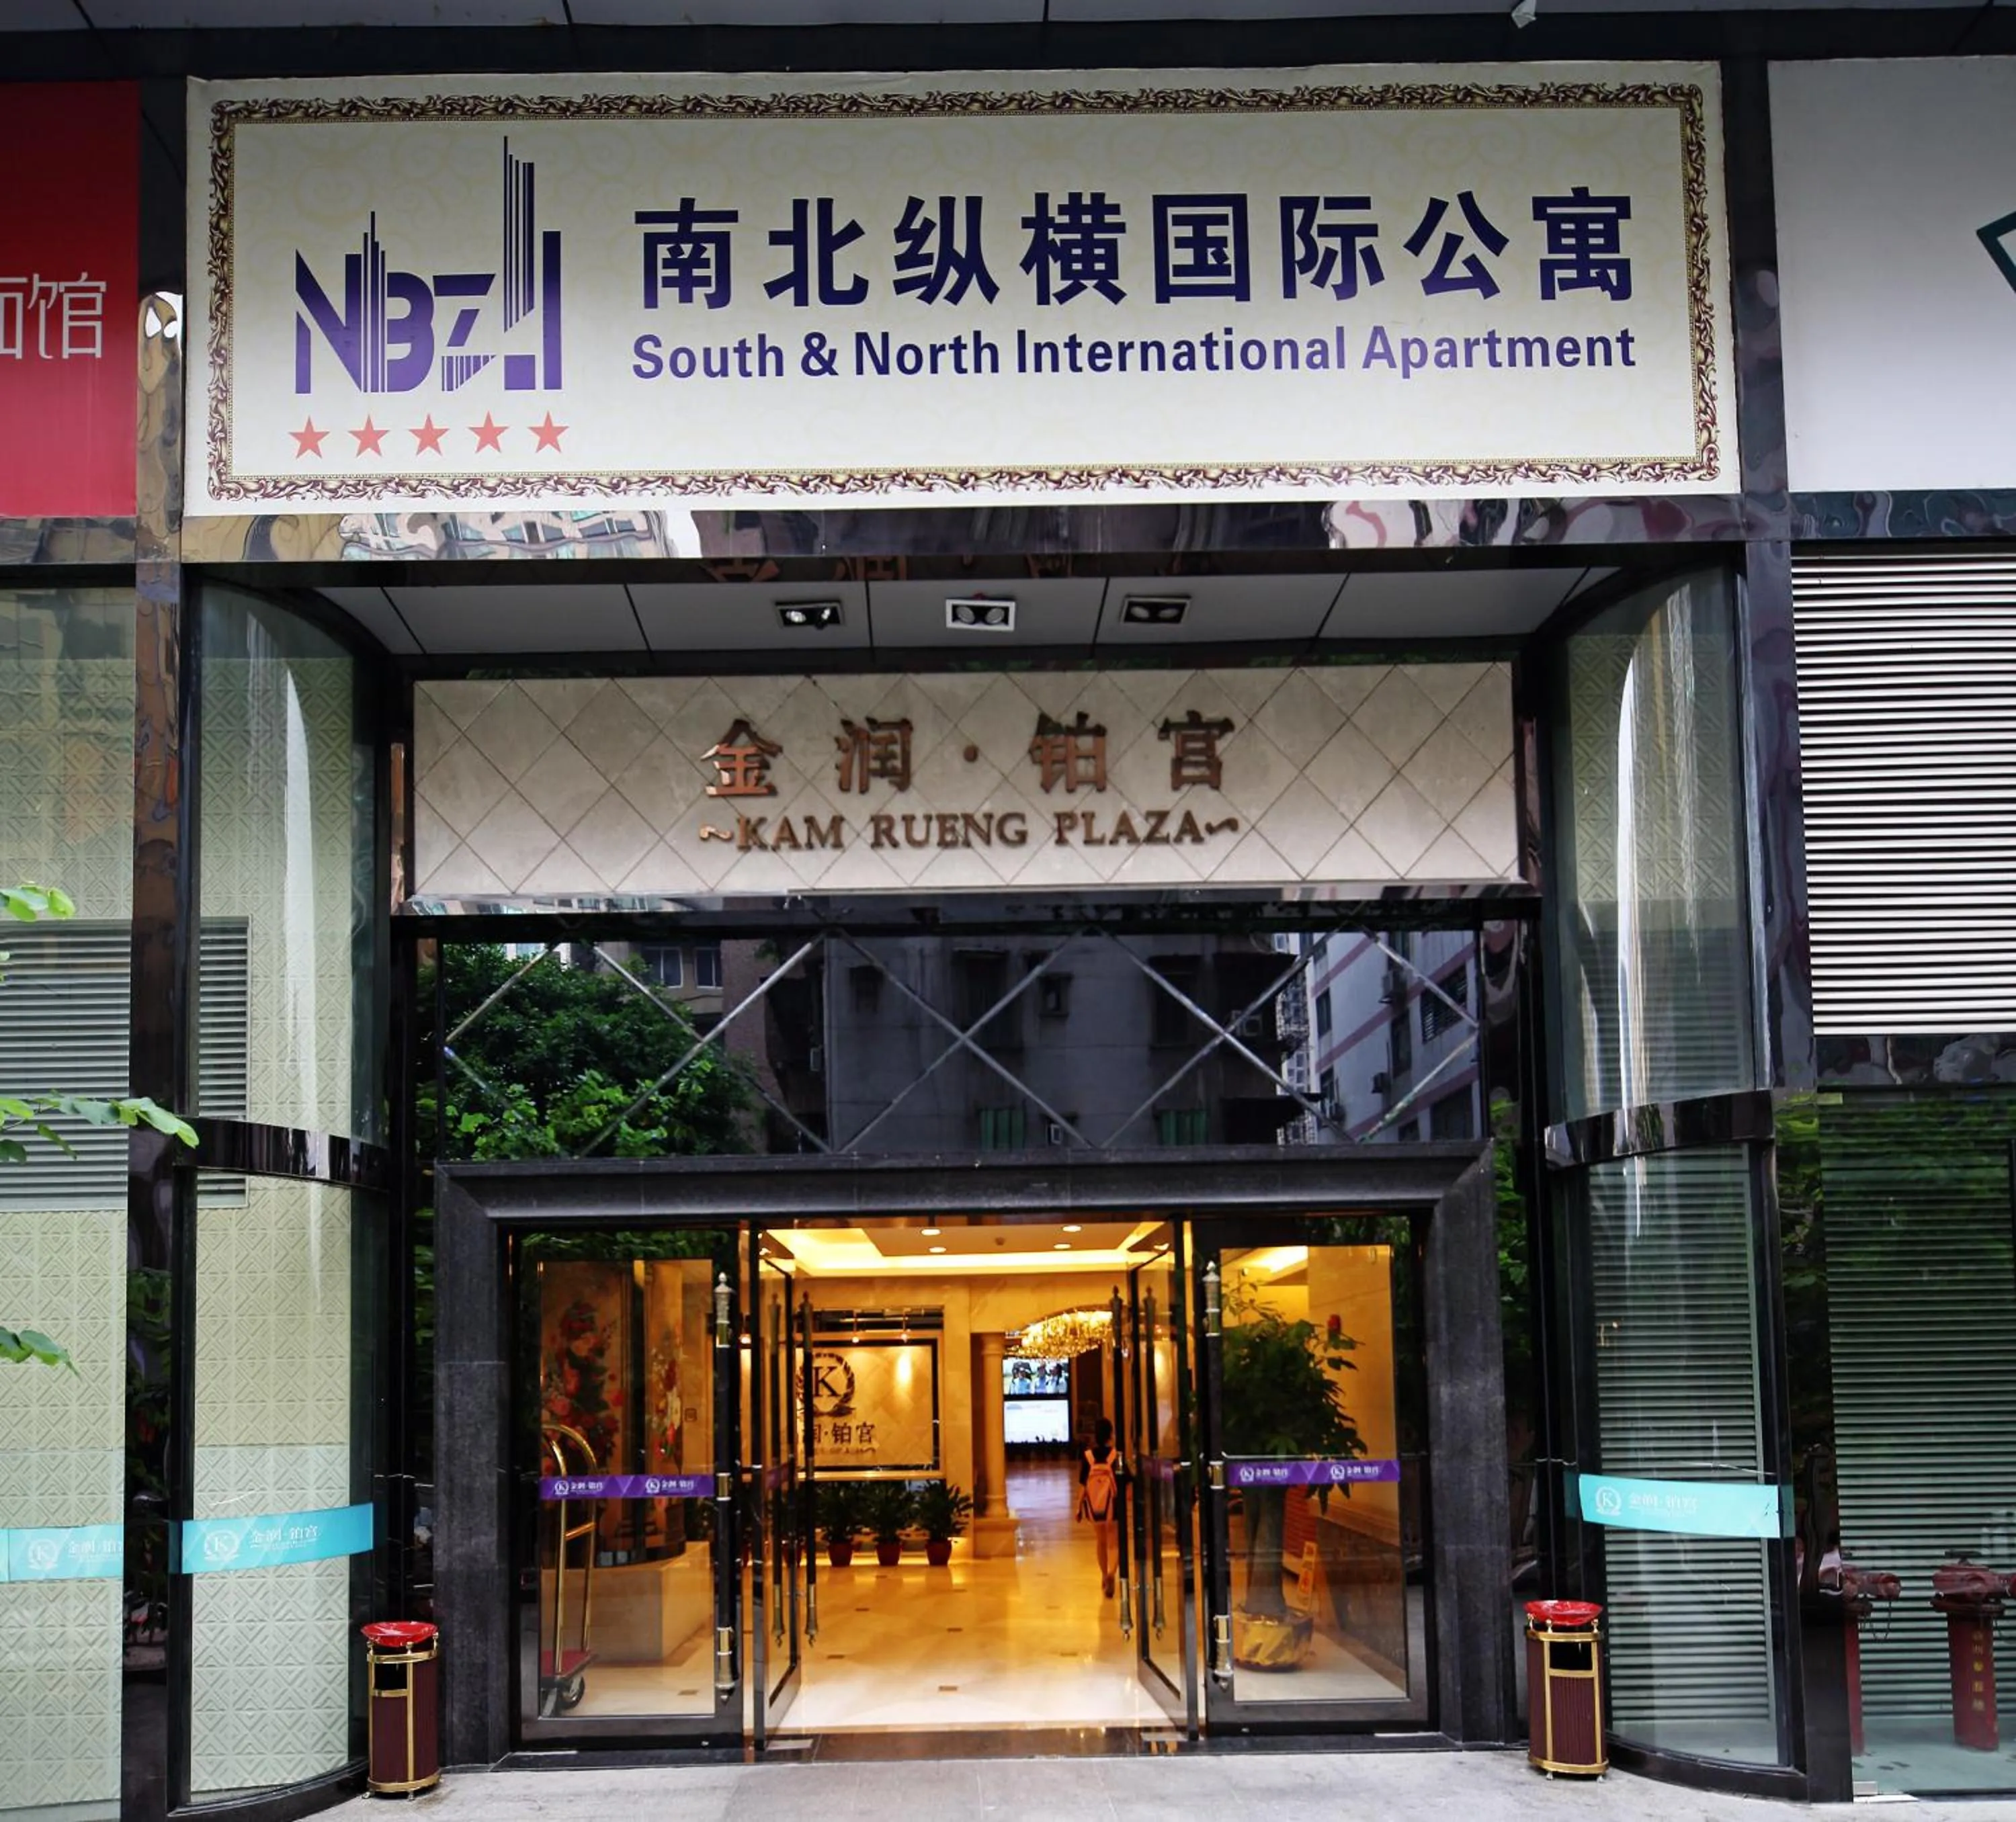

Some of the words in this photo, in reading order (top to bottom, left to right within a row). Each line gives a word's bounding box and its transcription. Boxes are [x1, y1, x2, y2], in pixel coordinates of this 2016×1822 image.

[634, 186, 1632, 309] 南北纵横国际公寓
[632, 333, 784, 379] South
[800, 331, 839, 376] &
[855, 330, 1000, 376] North
[1017, 325, 1345, 375] International
[1361, 325, 1636, 379] Apartment
[700, 709, 1235, 795] 金润·铂宫
[870, 812, 1028, 850] RUENG
